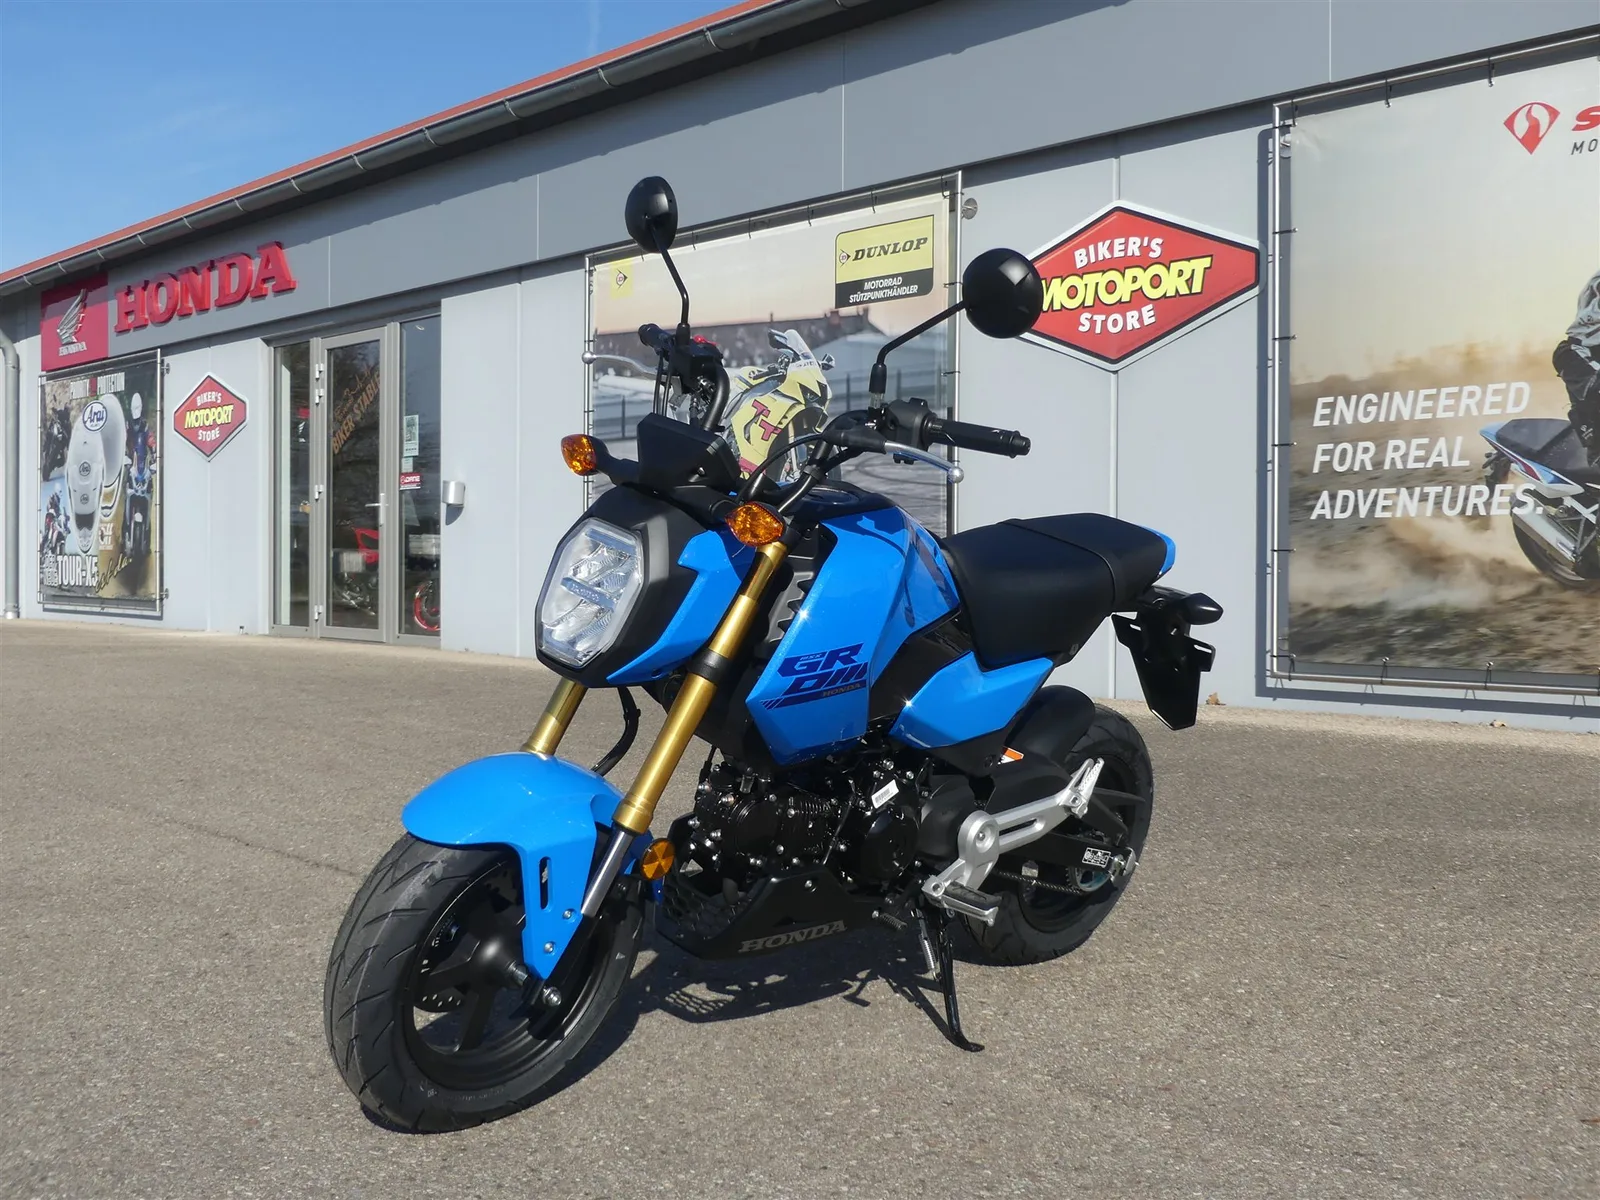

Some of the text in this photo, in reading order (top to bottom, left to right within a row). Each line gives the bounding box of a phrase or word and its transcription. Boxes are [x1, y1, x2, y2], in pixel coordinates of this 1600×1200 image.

[1570, 138, 1599, 156] MO
[852, 237, 928, 262] DUNLOP
[1073, 236, 1164, 270] BIKER'S
[113, 240, 298, 334] HONDA
[849, 284, 919, 304] STÜTZPUNKTHÄNDLER
[863, 276, 903, 291] MOTORRAD
[1041, 254, 1214, 313] MOTOPORT
[1078, 303, 1157, 334] STORE
[196, 391, 222, 407] BIKER'S
[1312, 381, 1531, 427] ENGINEERED
[184, 404, 235, 430] MOTOPORT
[198, 427, 220, 442] STORE
[332, 415, 355, 454] BIKER
[1312, 435, 1471, 474] FOR REAL
[1310, 482, 1544, 520] ADVENTURES.
[57, 554, 99, 587] TOUR-X5
[822, 682, 861, 698] HONDA
[738, 919, 848, 954] HONDA
